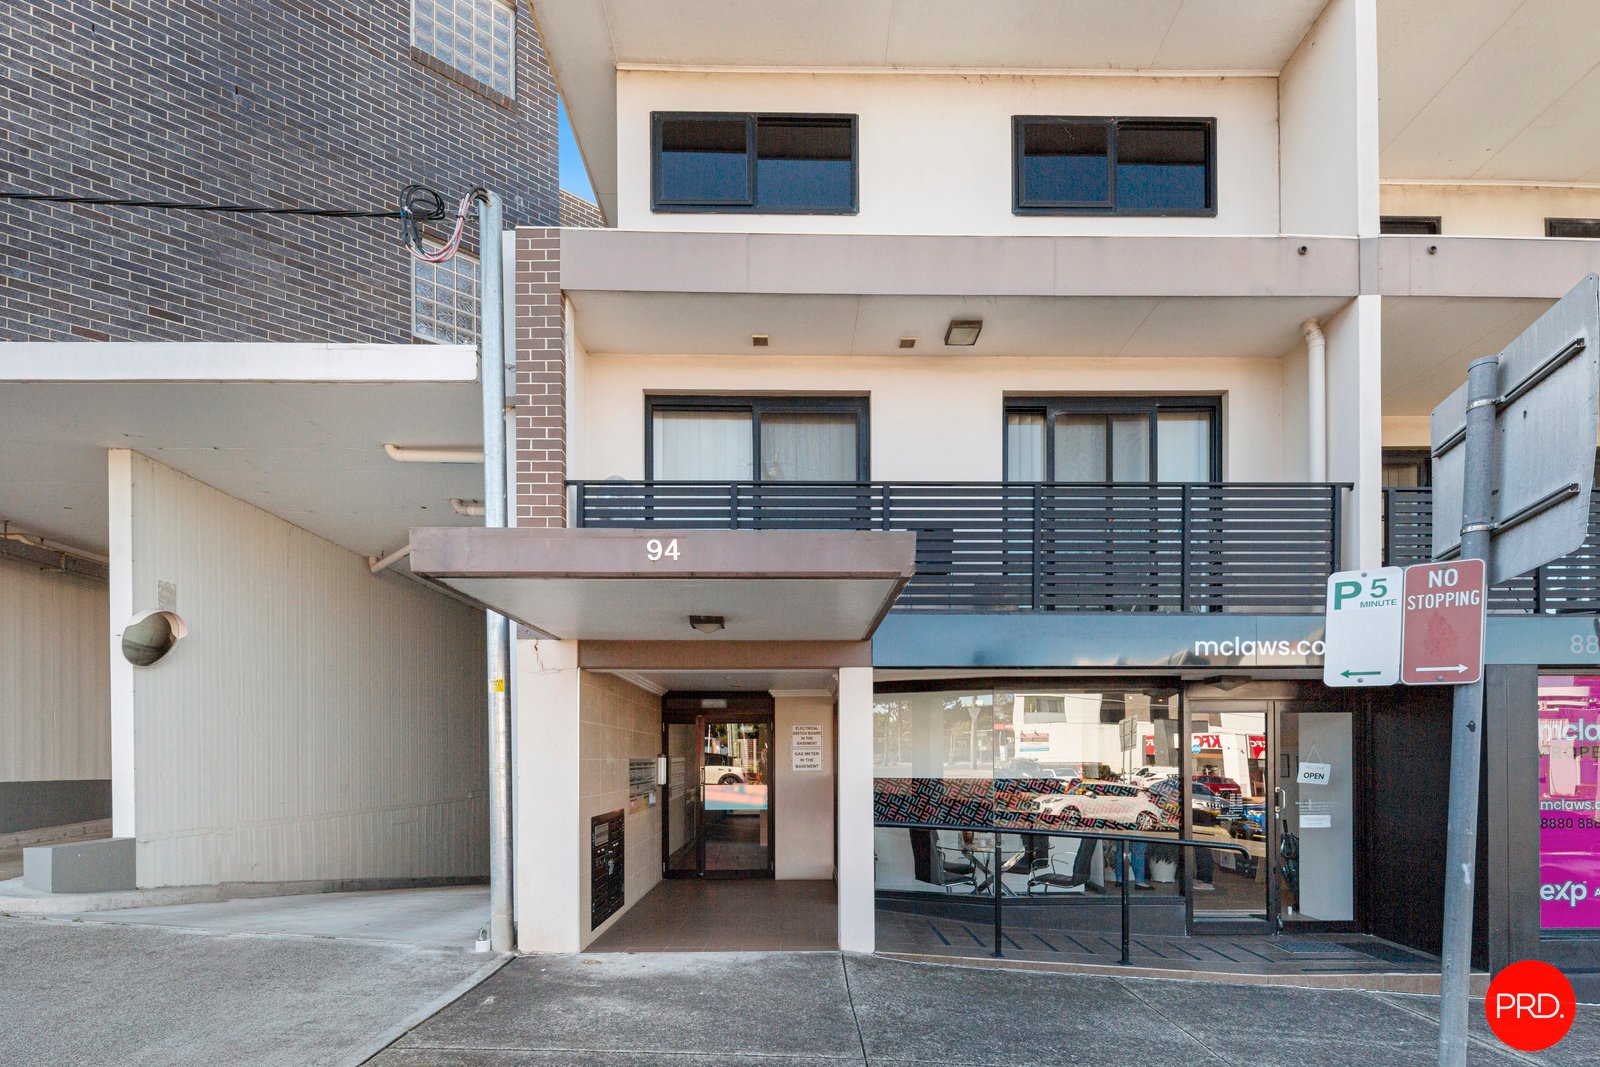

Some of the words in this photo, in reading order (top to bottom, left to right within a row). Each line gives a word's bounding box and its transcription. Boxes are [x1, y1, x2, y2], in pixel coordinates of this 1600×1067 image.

[646, 539, 681, 561] 94
[1428, 568, 1459, 588] NO
[1334, 581, 1362, 610] P
[1370, 578, 1388, 598] 5
[1359, 598, 1398, 609] MINUTE
[1407, 590, 1480, 610] STOPPING
[1194, 636, 1326, 656] mclaws.co
[1571, 634, 1599, 654] 88
[1303, 772, 1325, 780] OPEN
[1541, 818, 1573, 829] 8880
[1540, 881, 1587, 907] exp
